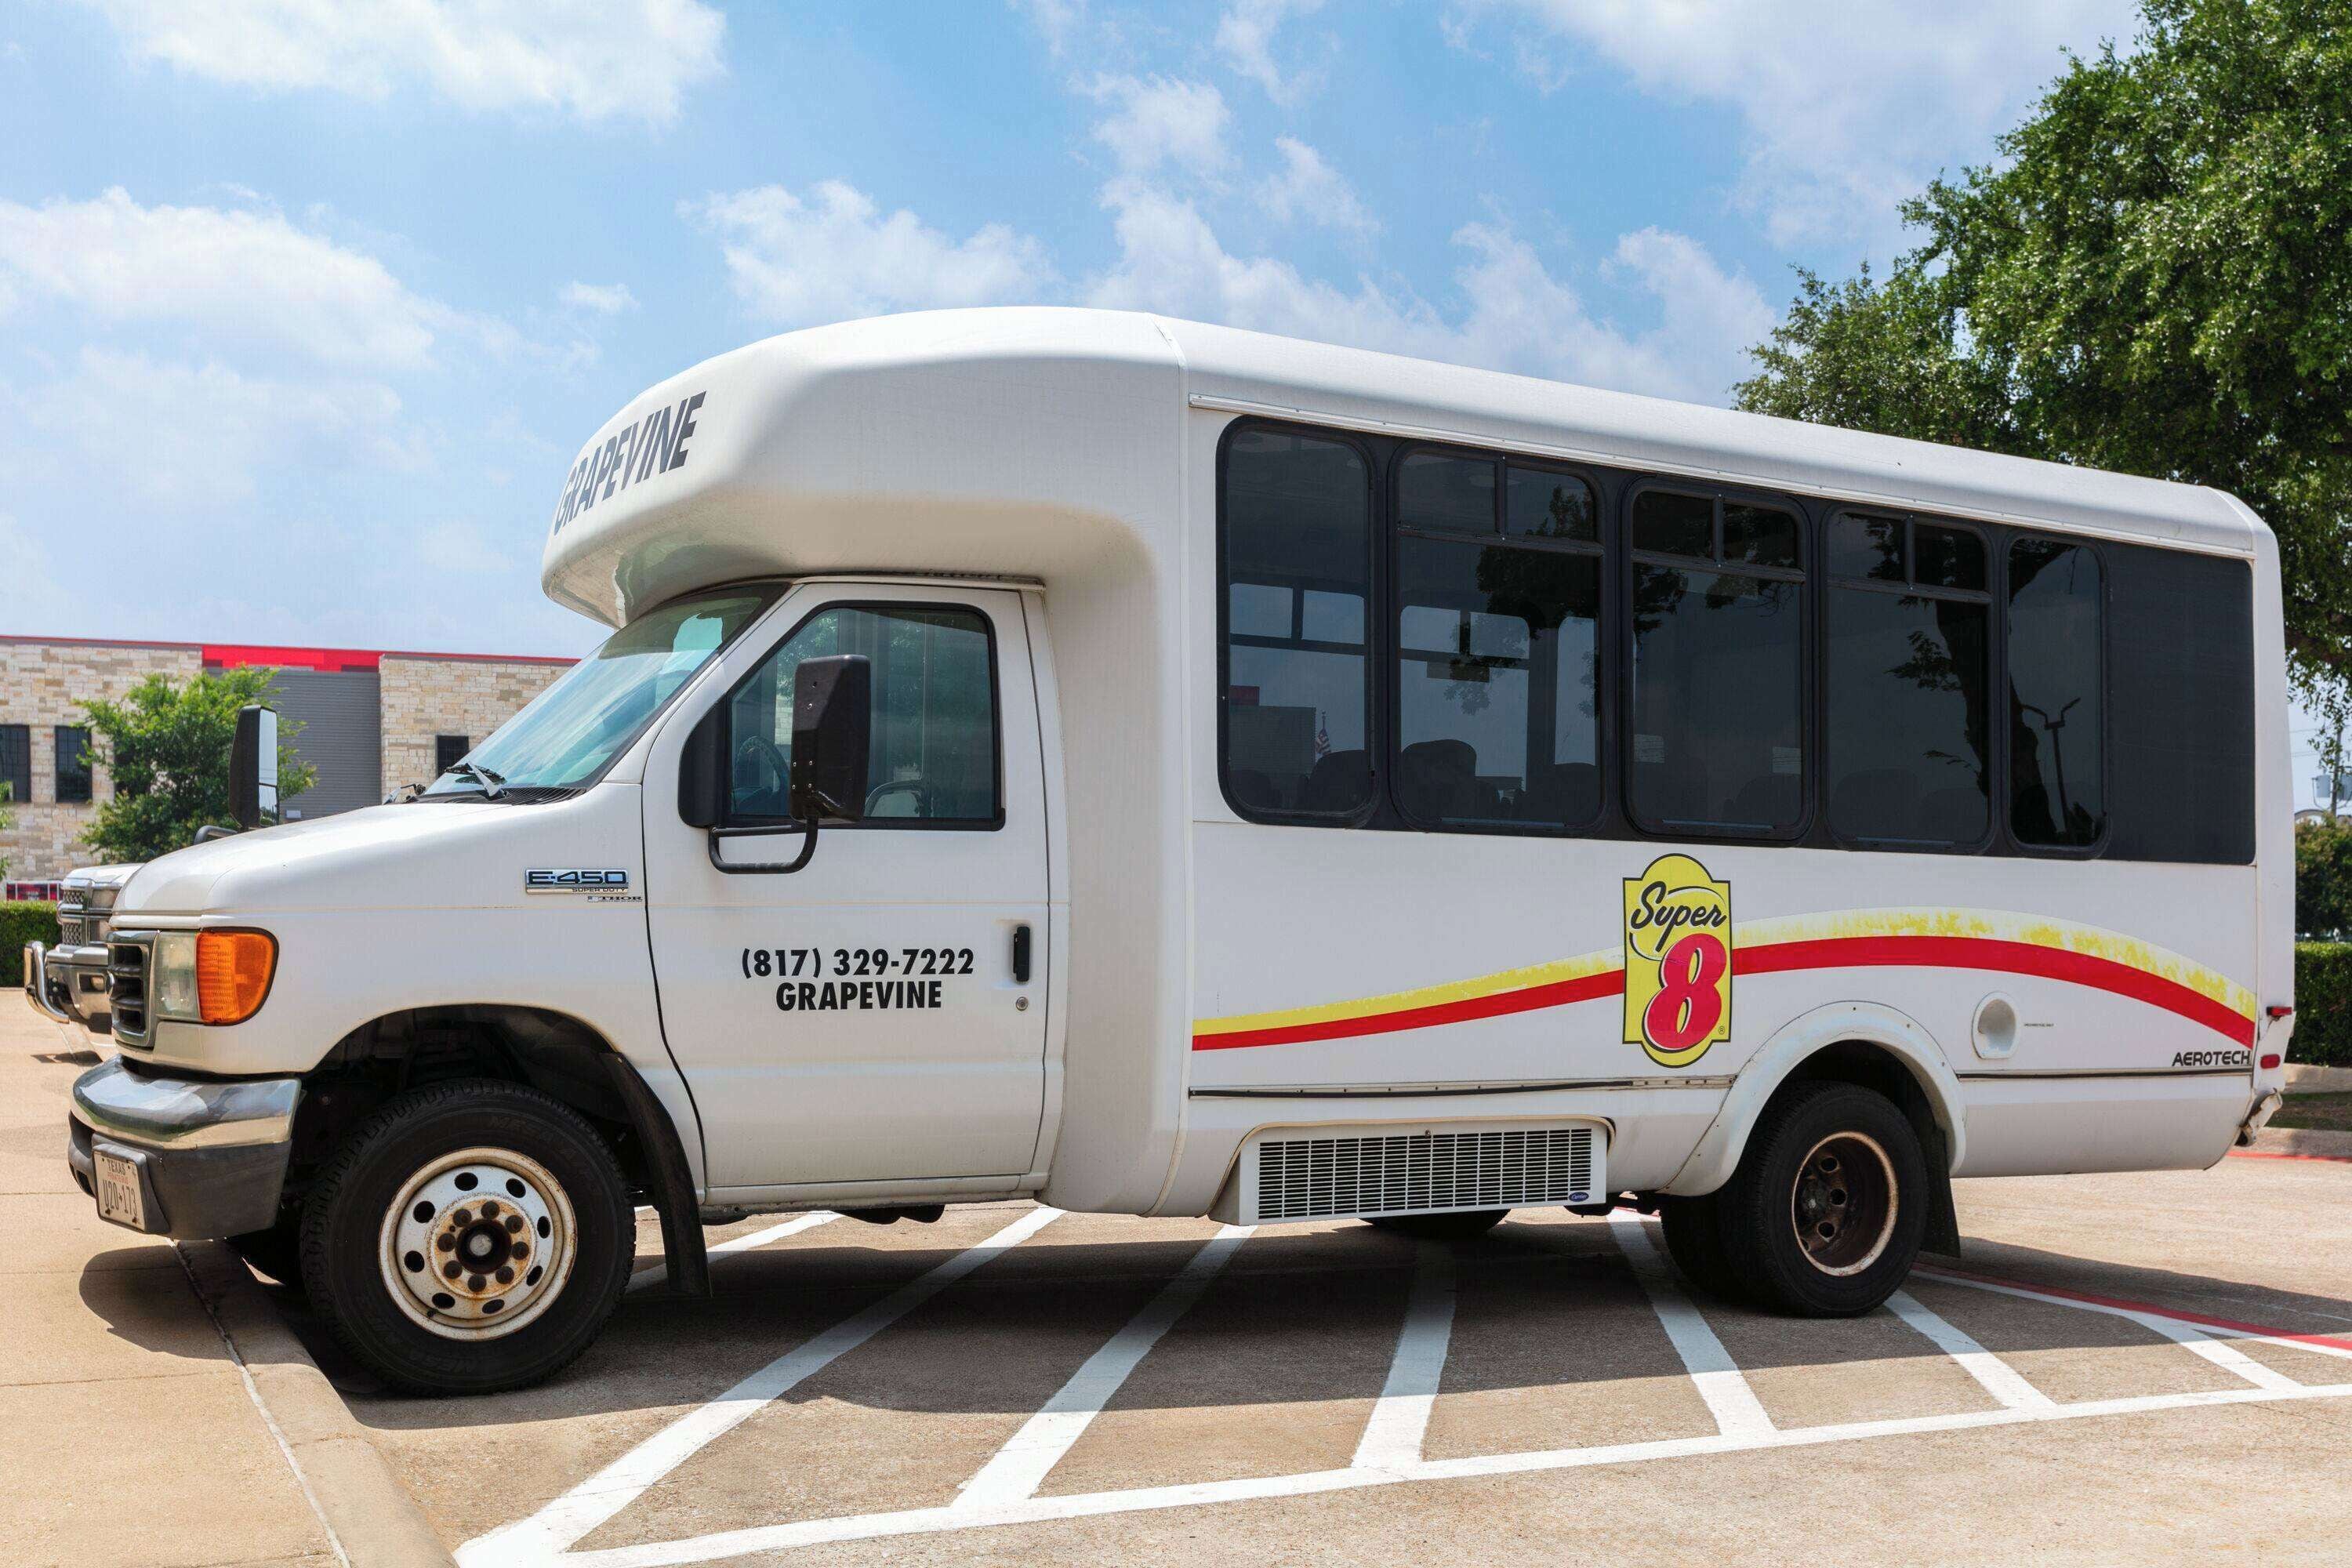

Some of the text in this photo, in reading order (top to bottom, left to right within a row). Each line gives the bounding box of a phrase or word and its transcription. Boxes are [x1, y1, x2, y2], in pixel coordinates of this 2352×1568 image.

[554, 390, 706, 535] GRAPEVINE
[528, 871, 626, 884] E-450
[1631, 881, 1726, 953] Super
[742, 947, 974, 978] (817) 329-7222
[775, 981, 942, 1011] GRAPEVINE
[1642, 933, 1727, 1054] 8
[2172, 1051, 2251, 1067] AEROTECH
[108, 1160, 125, 1175] TEXAS
